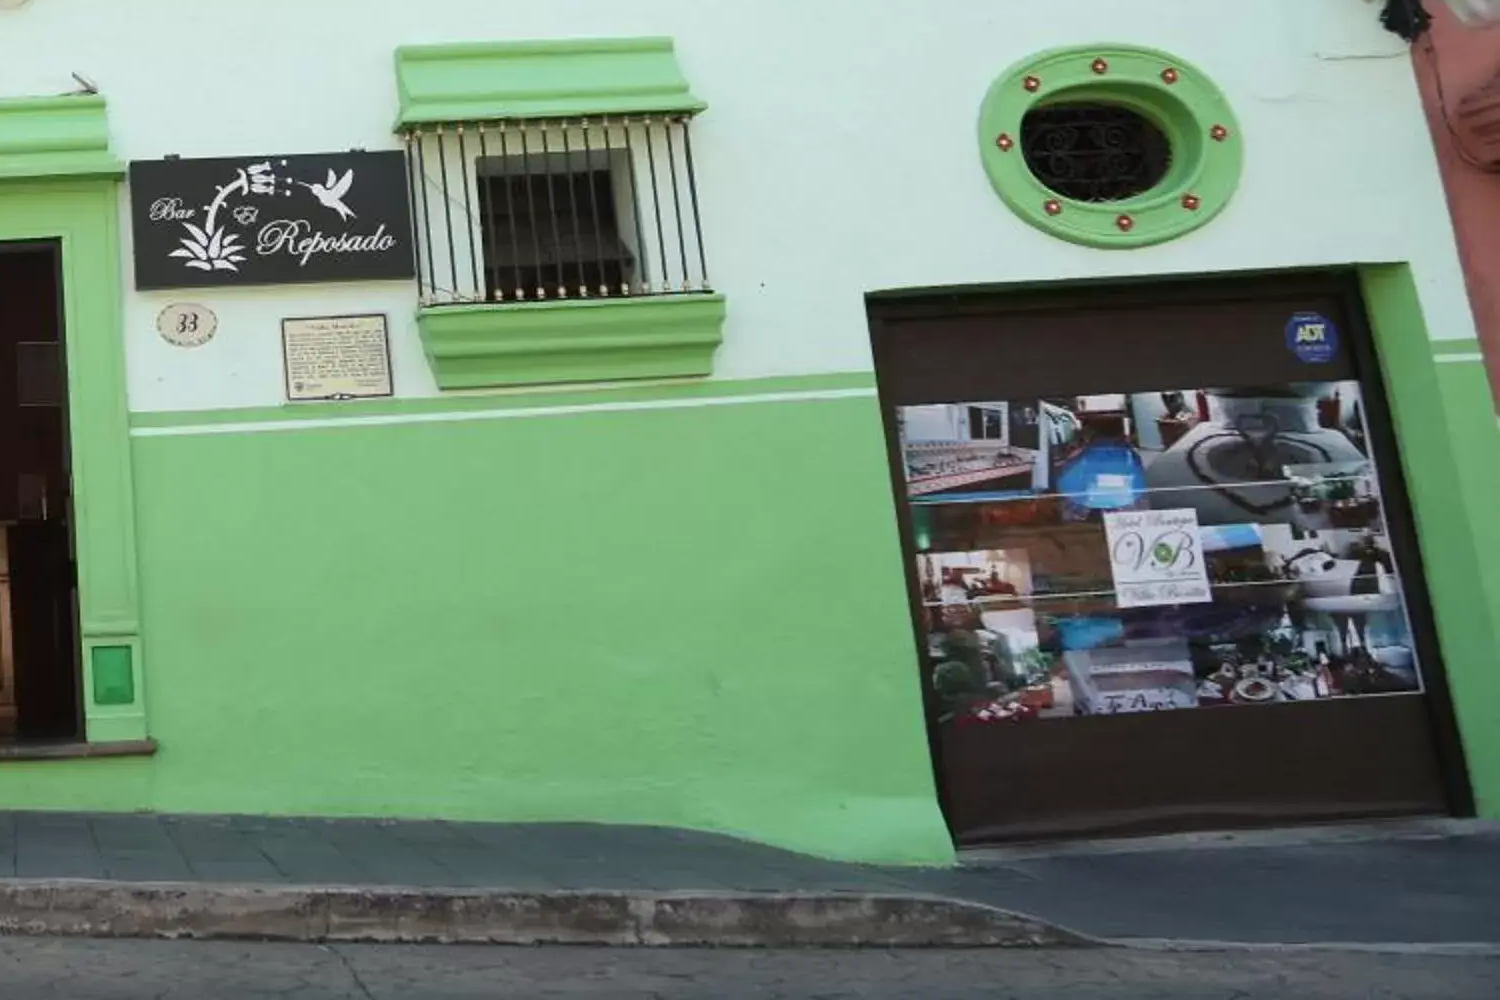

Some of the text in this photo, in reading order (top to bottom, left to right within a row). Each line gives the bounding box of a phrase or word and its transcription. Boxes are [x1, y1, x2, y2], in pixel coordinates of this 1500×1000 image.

[150, 197, 259, 225] Bar El
[256, 219, 395, 266] Reposado
[176, 313, 199, 334] 33
[1295, 324, 1325, 342] ADT
